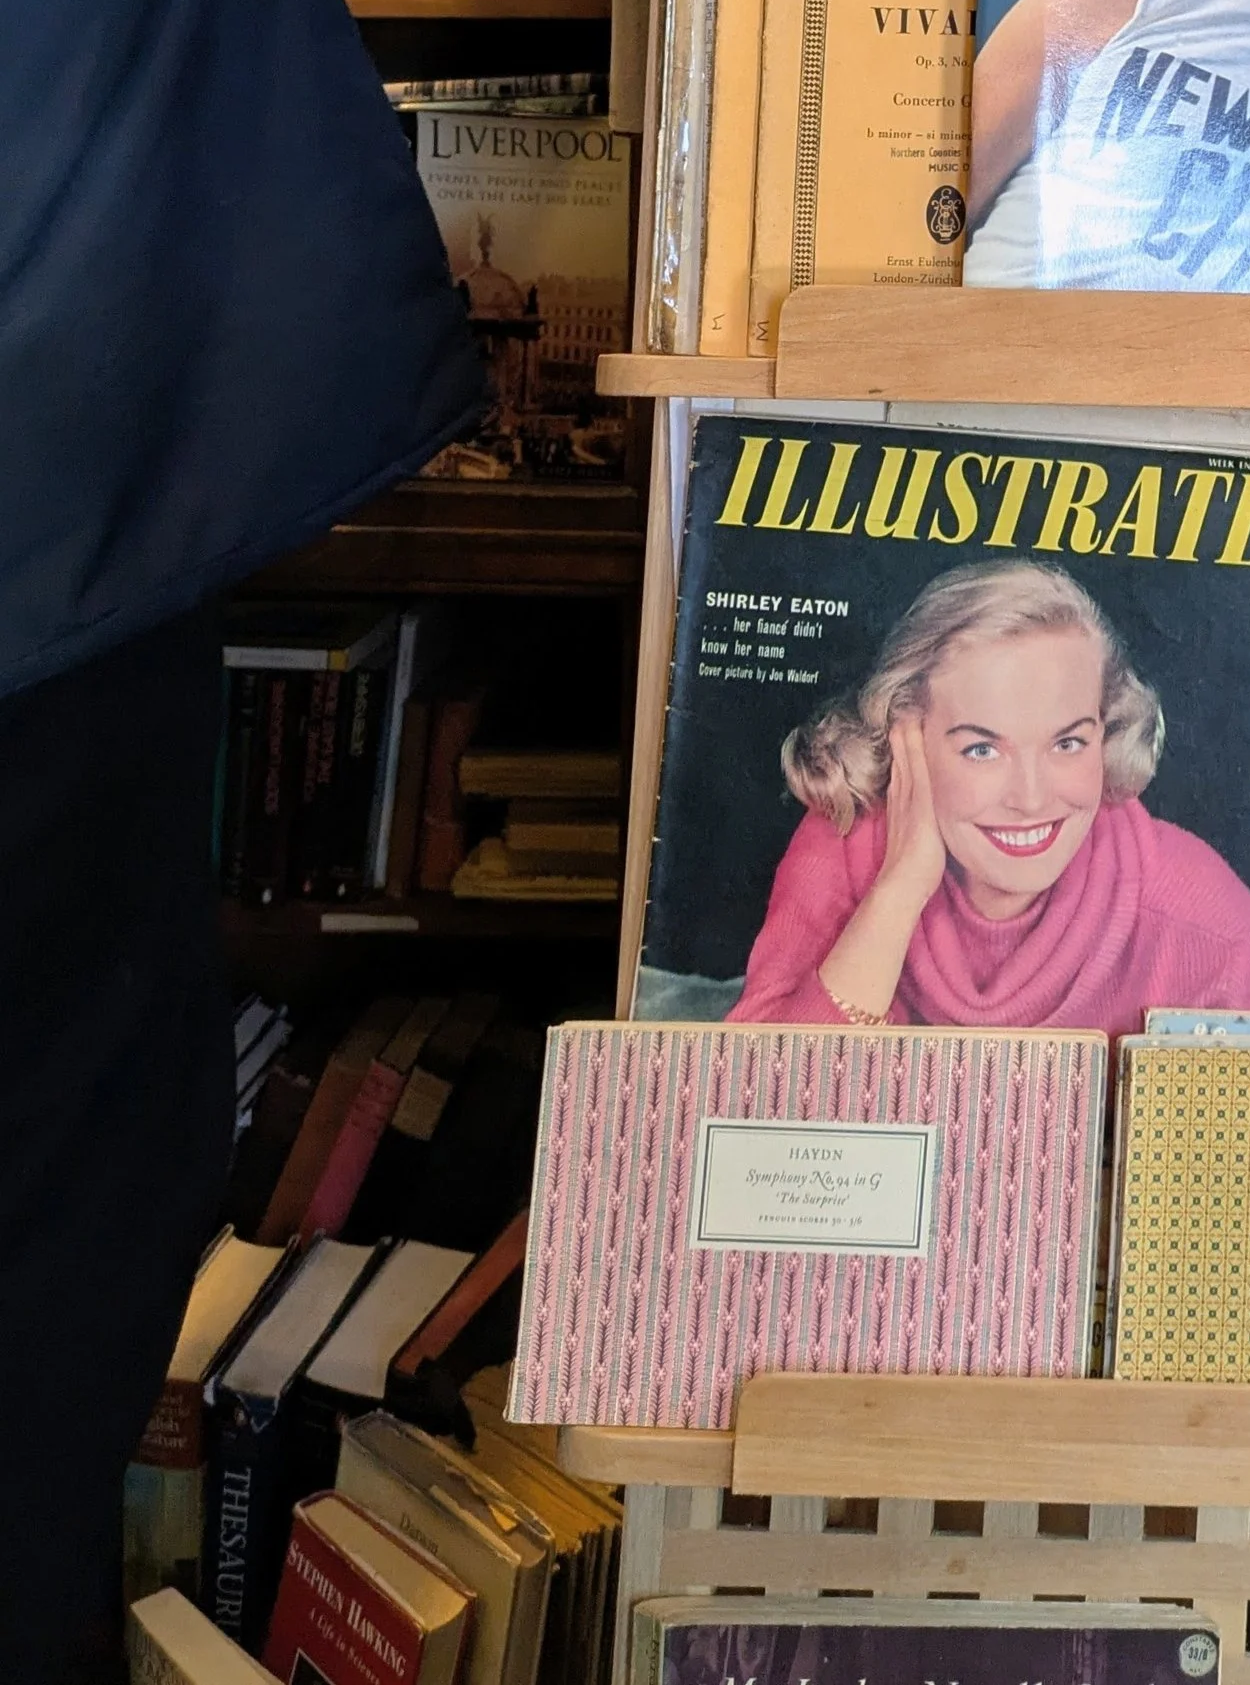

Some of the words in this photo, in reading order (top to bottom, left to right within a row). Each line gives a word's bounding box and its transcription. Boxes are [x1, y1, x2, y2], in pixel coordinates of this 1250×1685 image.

[914, 55, 933, 69] Op.
[892, 92, 955, 108] Concerto
[431, 118, 623, 163] LIVERPOOL
[877, 128, 912, 140] minor
[928, 163, 960, 174] MUSIC
[886, 255, 914, 268] Ernst
[1208, 457, 1235, 470] WEEK
[705, 591, 783, 612] SHIRLEY
[790, 598, 850, 618] EATON
[733, 616, 752, 633] her
[756, 618, 789, 635] fiancé
[793, 621, 823, 639] didn't
[701, 637, 728, 654] know
[734, 640, 752, 657] her
[757, 644, 786, 659] name
[698, 662, 722, 677] Cover
[724, 665, 754, 681] picture
[788, 1147, 844, 1162] HAYDN
[745, 1168, 809, 1189] Symphony
[809, 1170, 835, 1192] No.
[835, 1176, 851, 1188] 94
[869, 1172, 883, 1192] G
[758, 1214, 797, 1223] PENGUIN
[287, 1538, 345, 1616] STEPHEN
[346, 1598, 407, 1677] HAWKING
